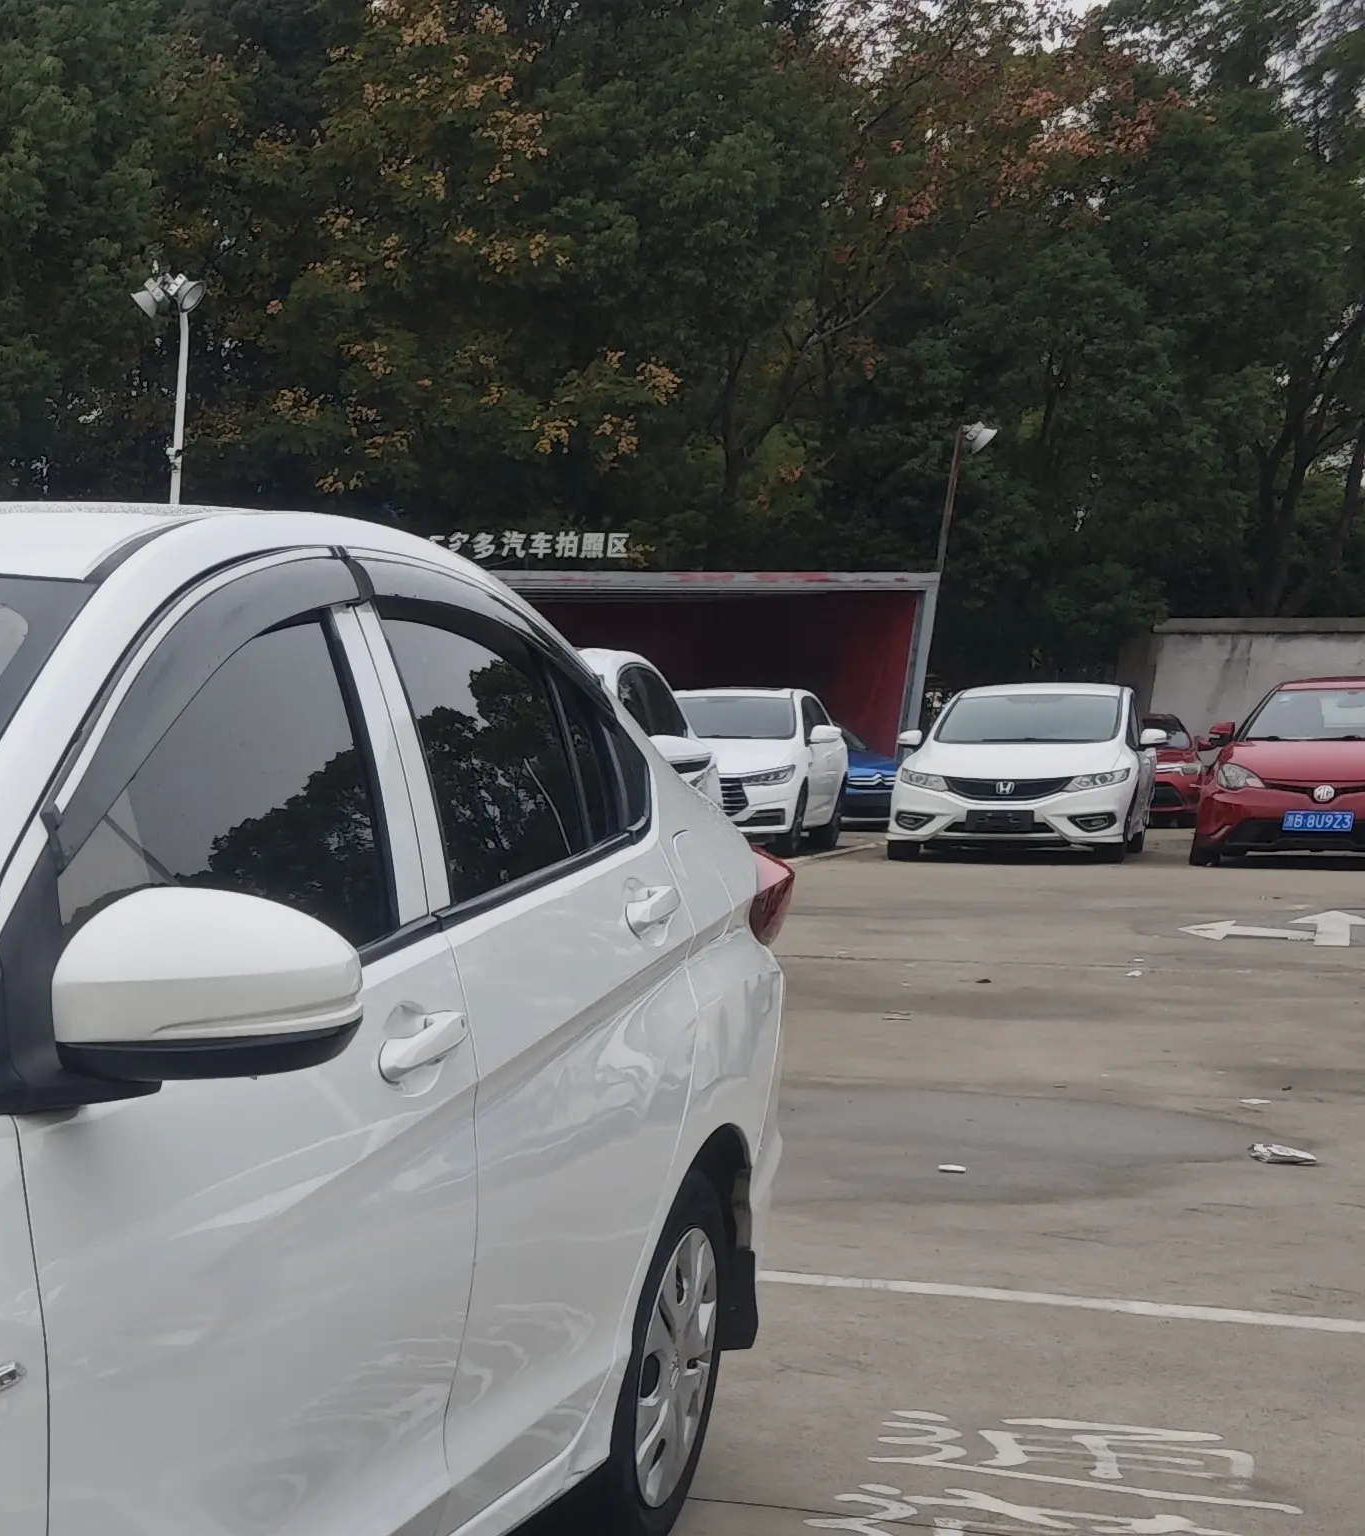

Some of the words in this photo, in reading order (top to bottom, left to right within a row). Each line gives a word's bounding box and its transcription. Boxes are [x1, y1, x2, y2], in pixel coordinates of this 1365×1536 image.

[428, 530, 630, 559] 多多汽车拍照区
